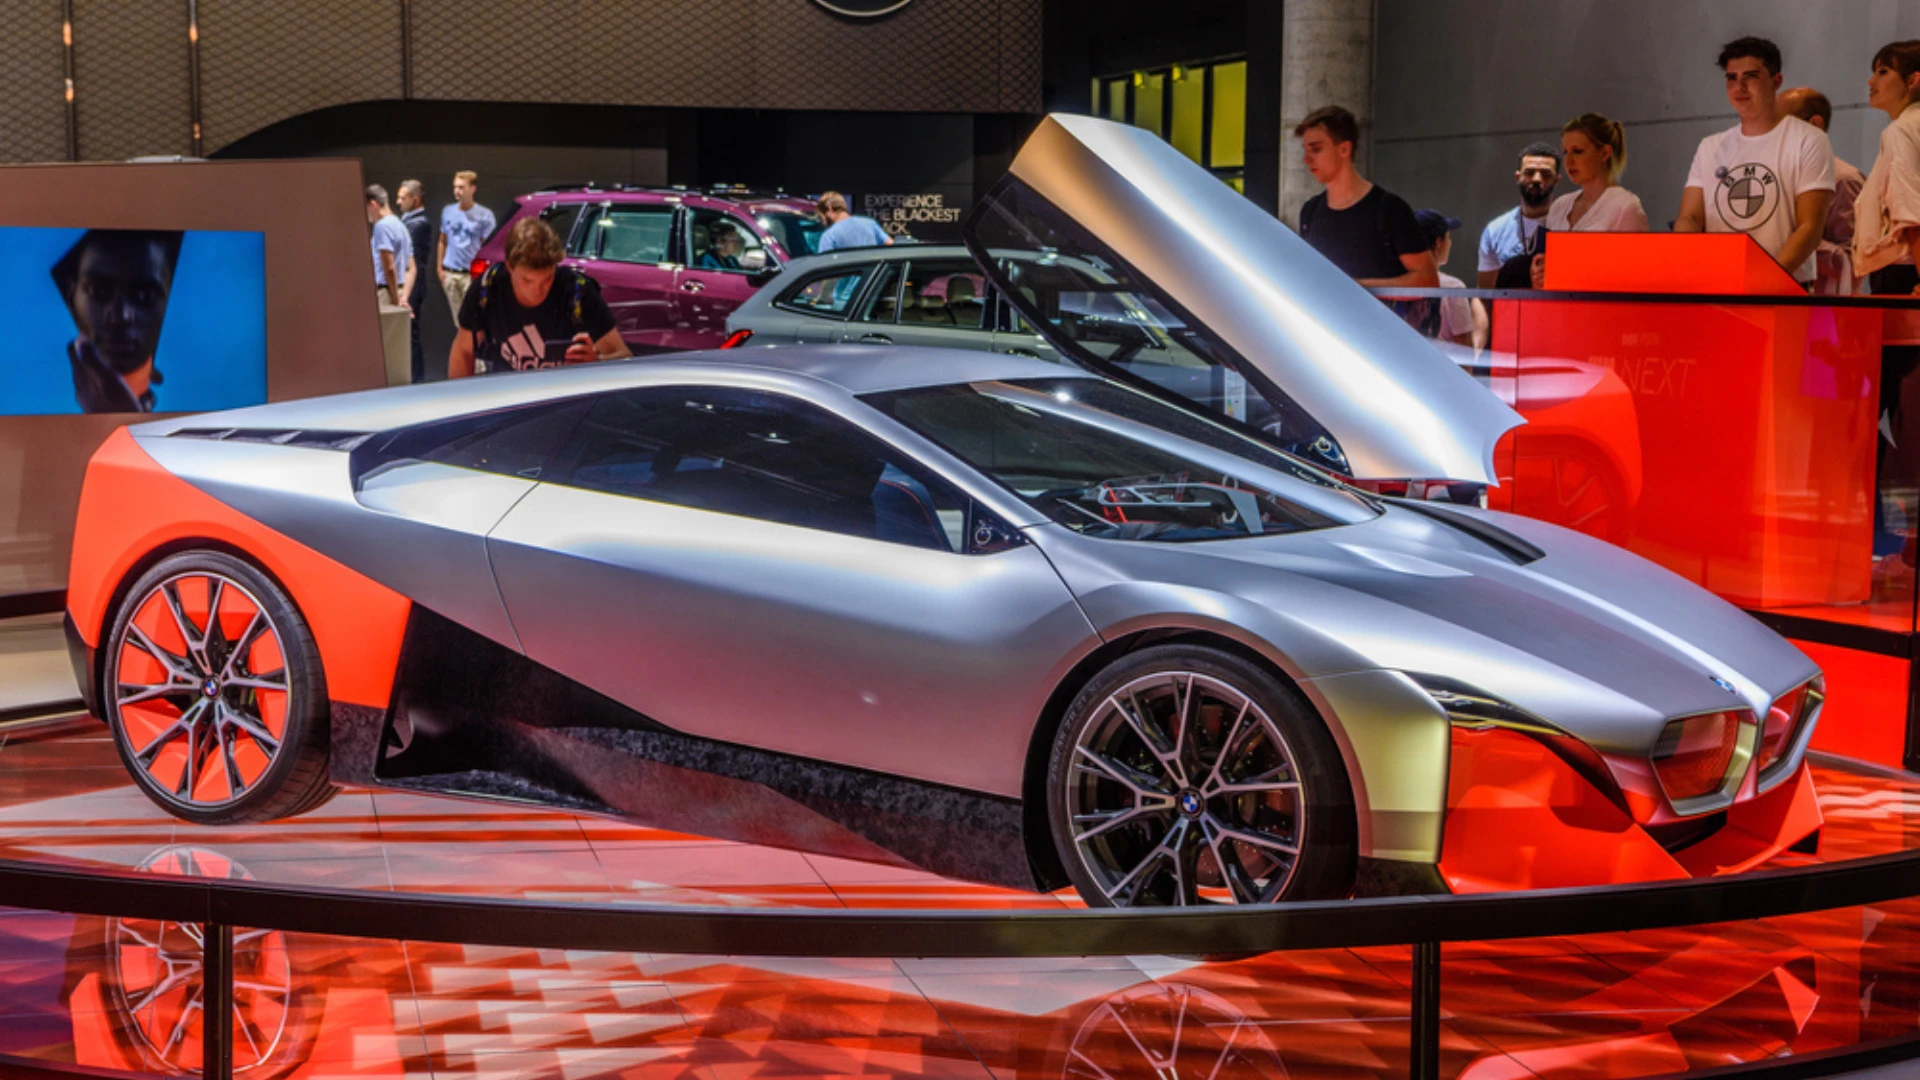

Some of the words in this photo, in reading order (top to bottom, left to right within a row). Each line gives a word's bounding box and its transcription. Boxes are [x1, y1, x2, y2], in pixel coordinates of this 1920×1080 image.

[1721, 166, 1775, 188] BMW
[864, 194, 943, 208] EXPERIENCE
[865, 208, 891, 220] THE
[893, 208, 961, 222] BLACKEST
